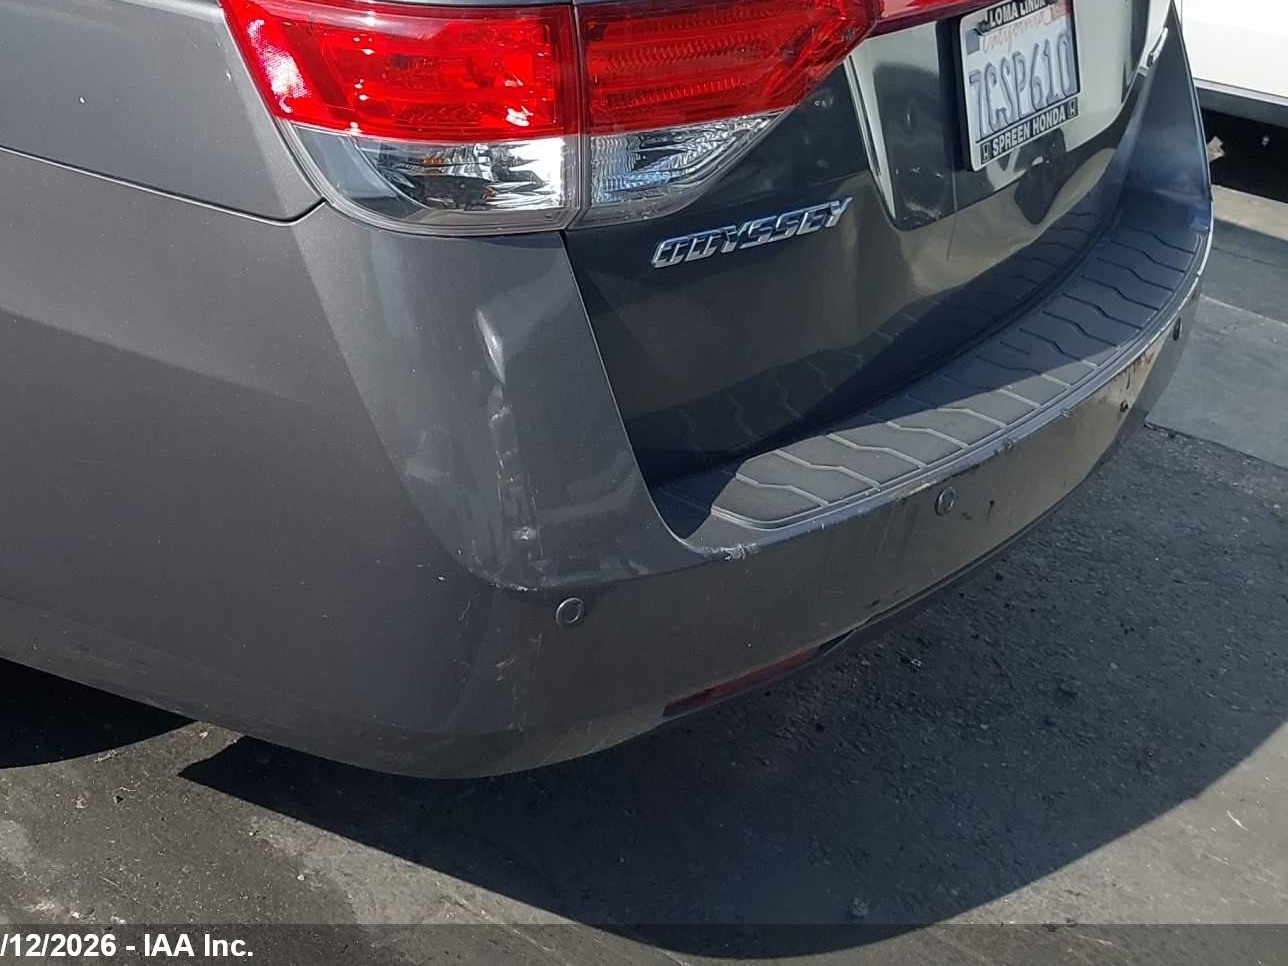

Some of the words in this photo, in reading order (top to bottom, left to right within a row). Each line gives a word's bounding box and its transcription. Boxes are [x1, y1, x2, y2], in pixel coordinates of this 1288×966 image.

[988, 1, 1019, 28] LOMA
[968, 34, 1074, 140] 7CSP610
[992, 120, 1031, 157] SPREEN
[1032, 104, 1067, 135] HONDA
[651, 196, 853, 269] ODYSSEY
